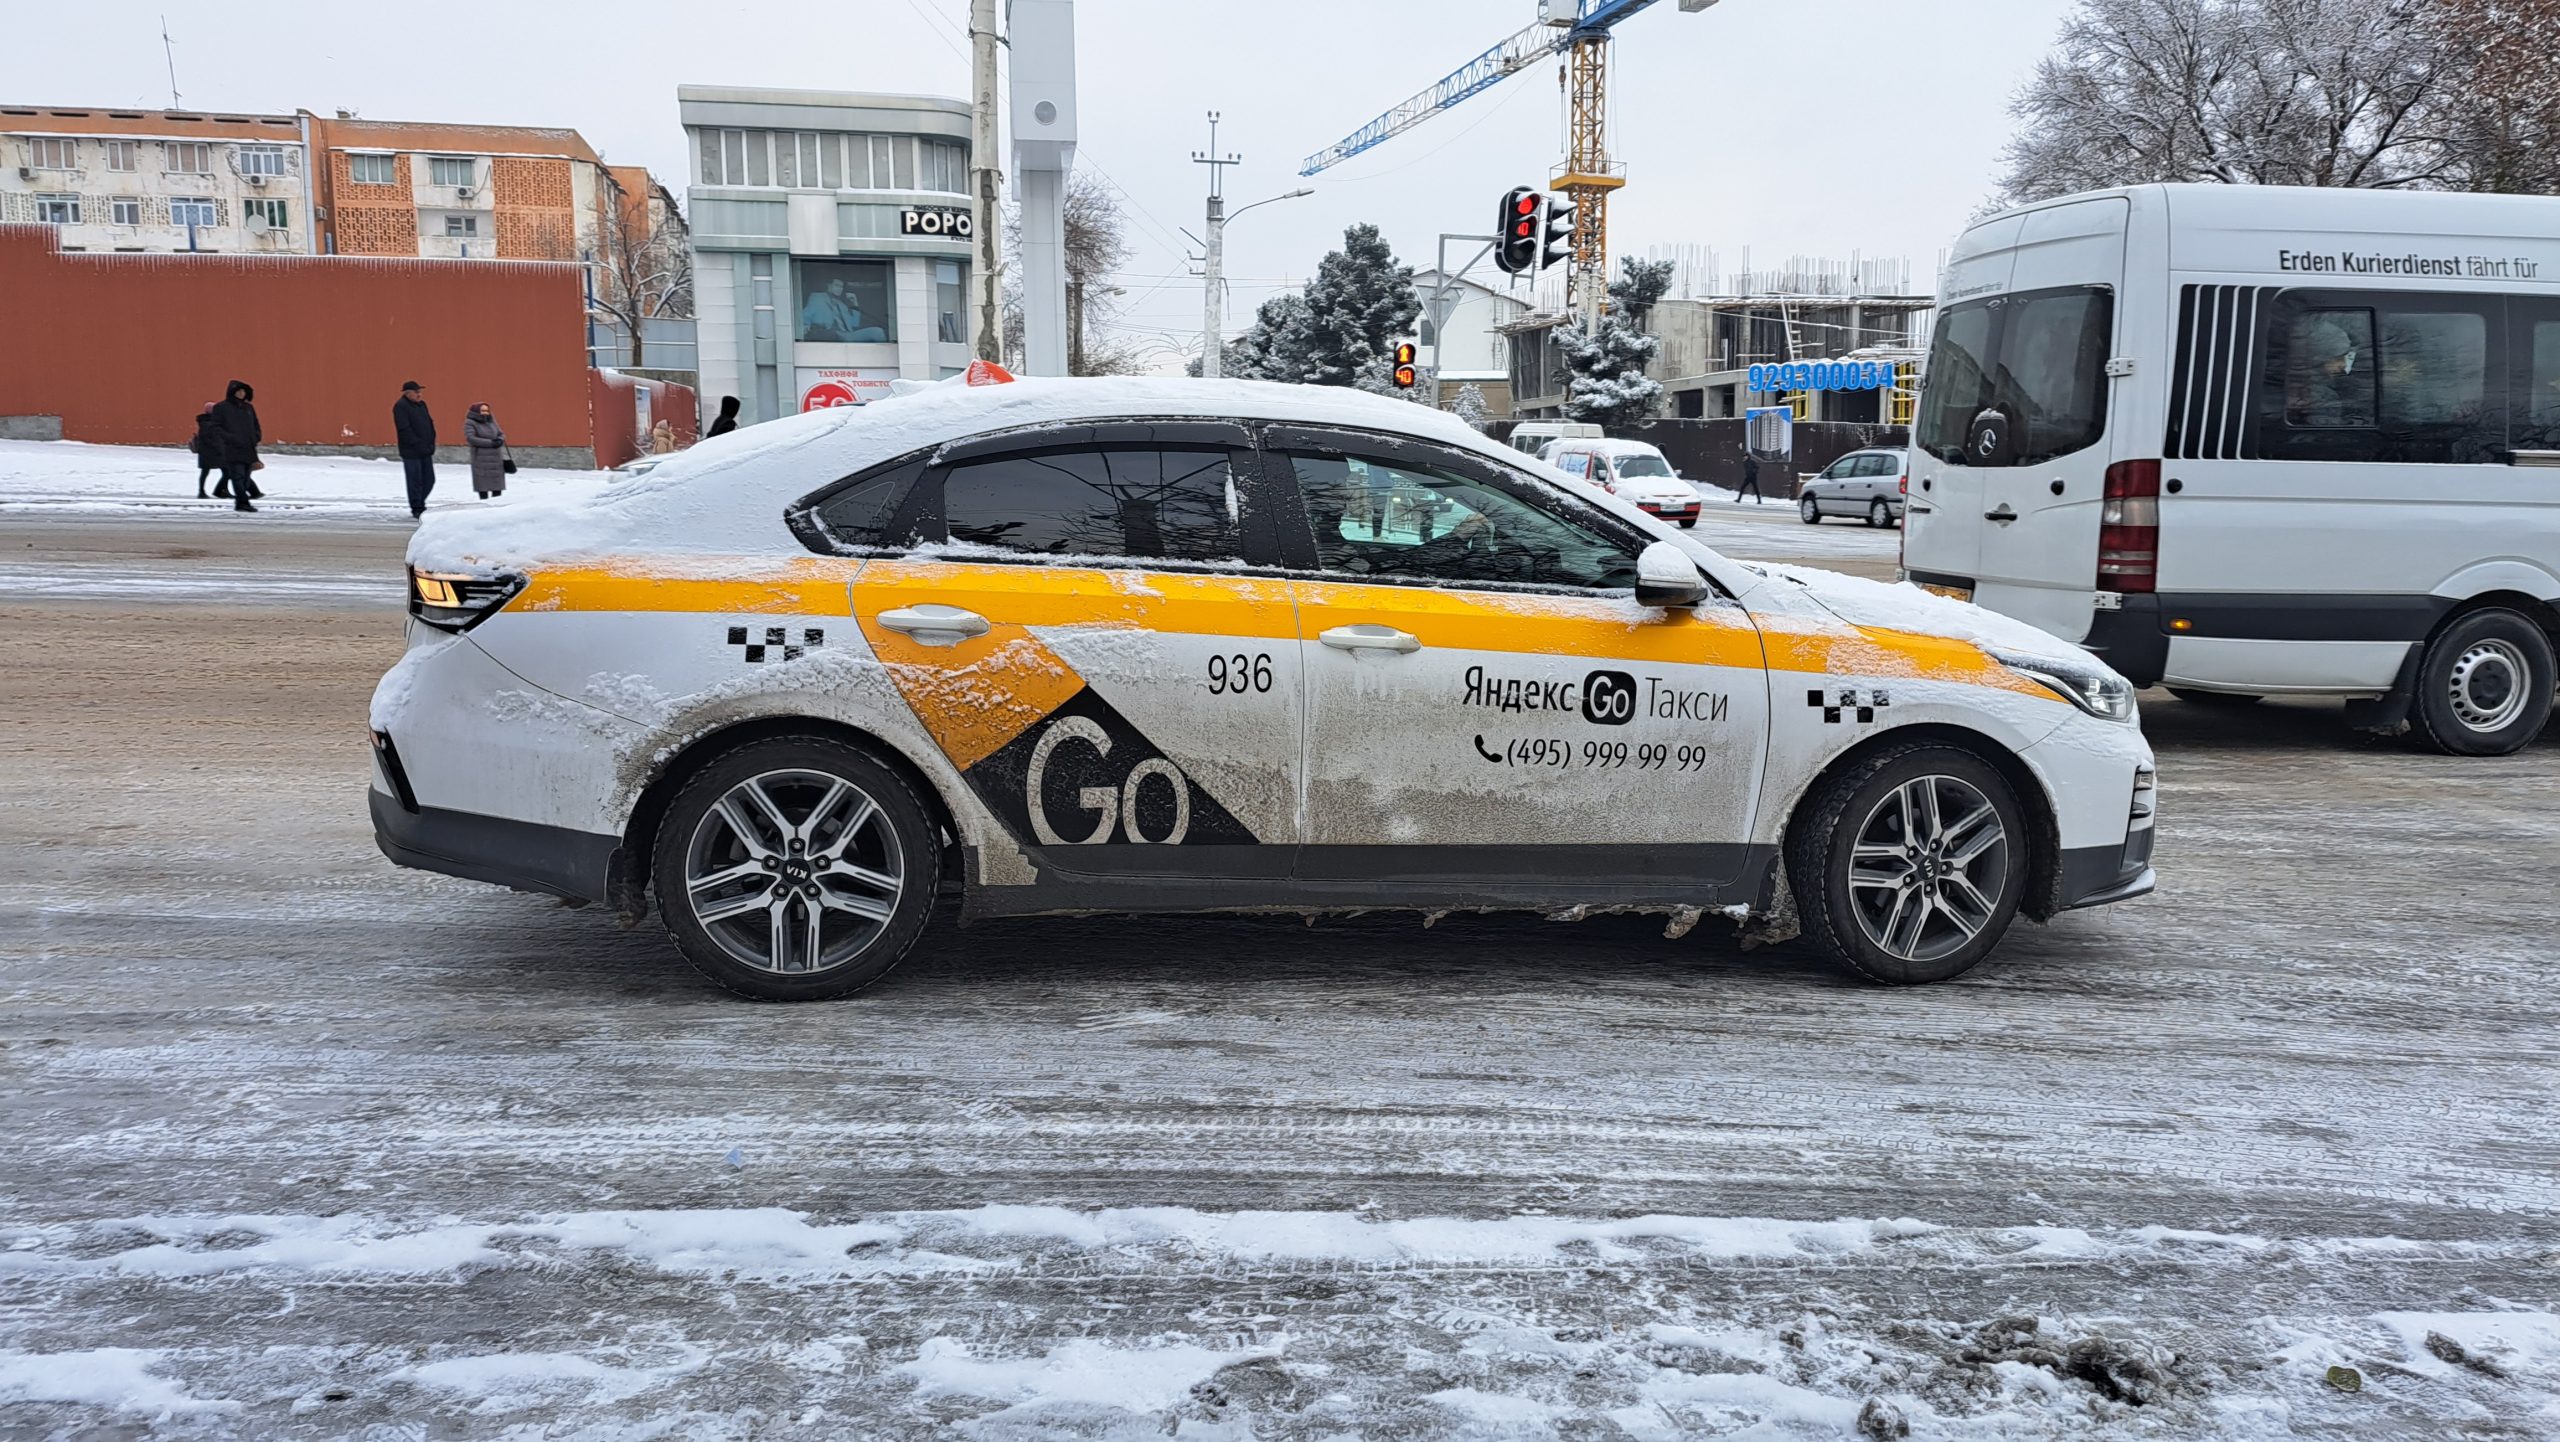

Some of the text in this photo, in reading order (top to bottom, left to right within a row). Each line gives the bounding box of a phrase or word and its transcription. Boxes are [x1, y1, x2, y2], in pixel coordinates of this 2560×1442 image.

[2279, 249, 2538, 279] Erden Kurierdienst fährt für
[1395, 369, 1412, 383] 40
[1748, 360, 1895, 393] 929300034
[1207, 653, 1273, 695] 936
[1462, 665, 1729, 722] Яндекс Go Такси
[1507, 738, 1706, 772] (495) 999 99 99
[1026, 715, 1190, 845] Go
[786, 864, 808, 880] KIA
